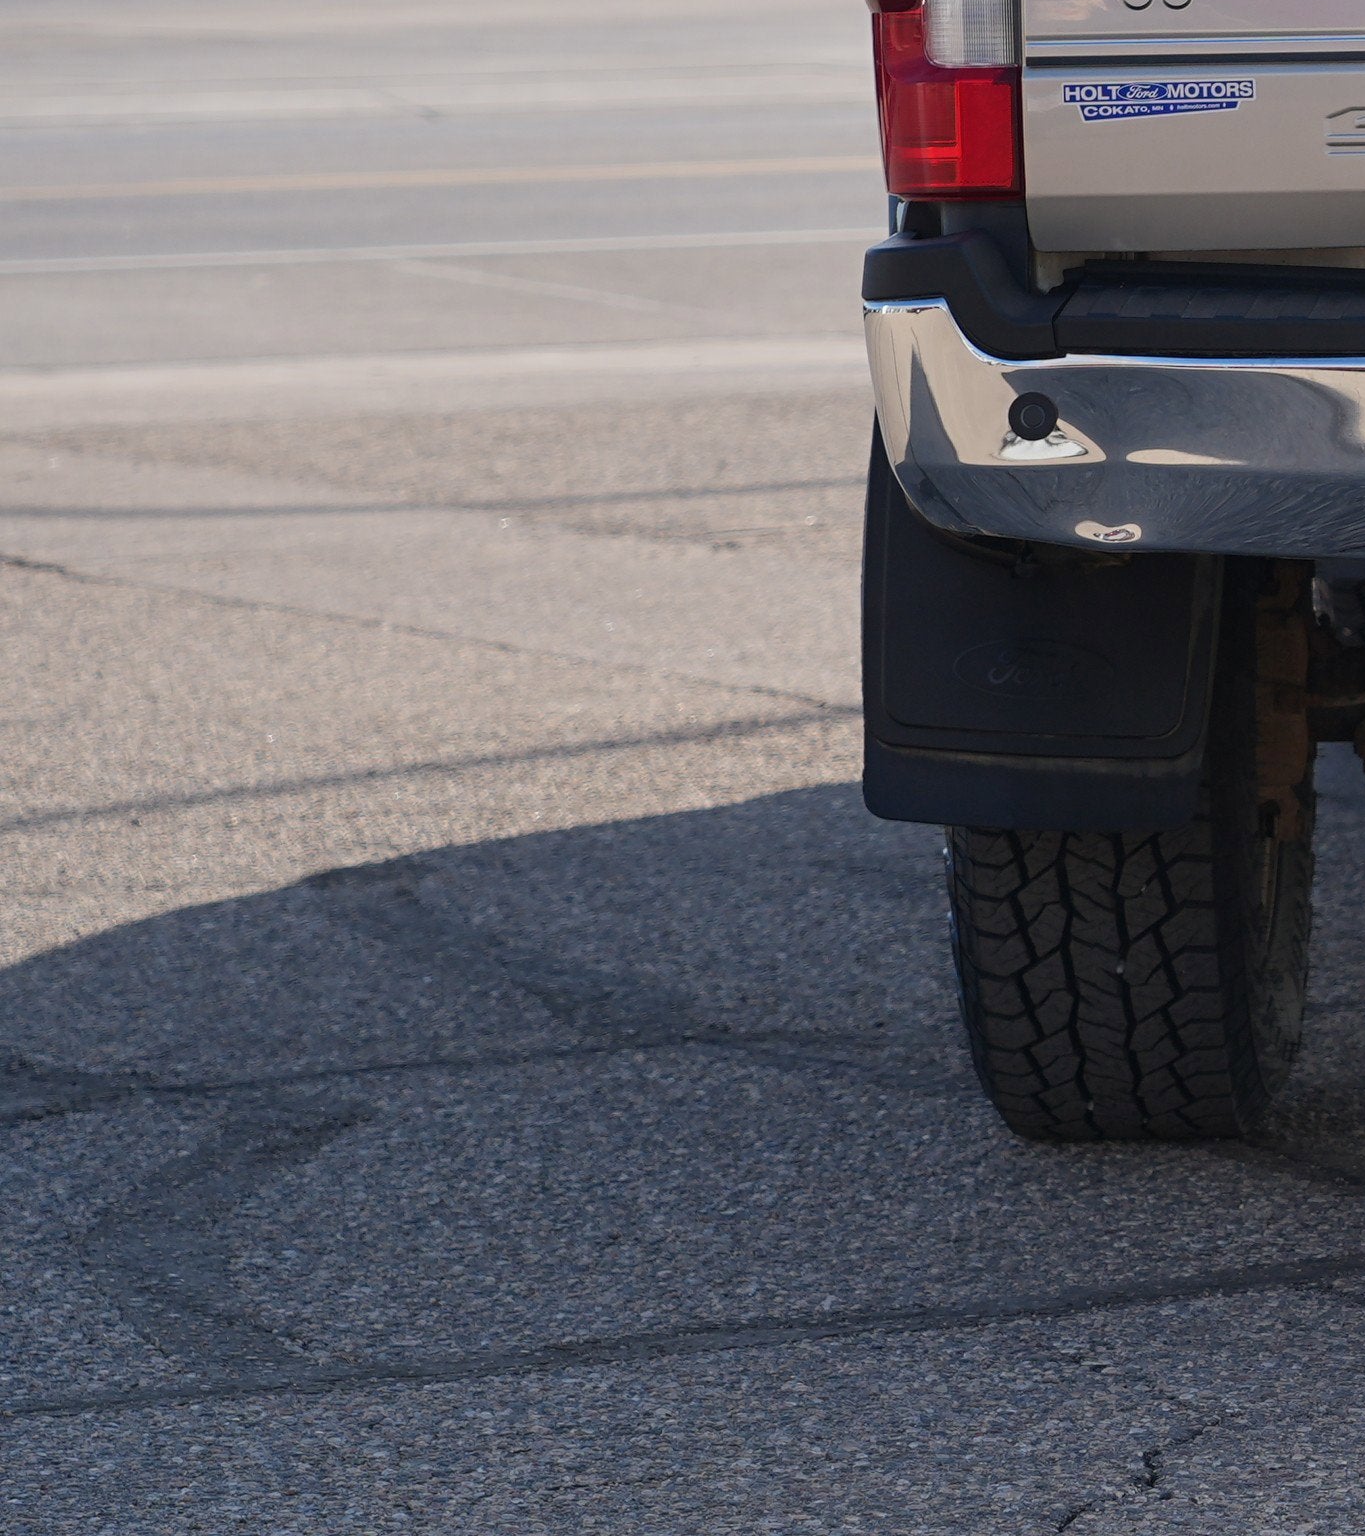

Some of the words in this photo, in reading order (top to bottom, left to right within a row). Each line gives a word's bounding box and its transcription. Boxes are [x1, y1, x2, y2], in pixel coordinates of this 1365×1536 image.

[1065, 84, 1119, 101] HOLT
[1126, 83, 1159, 99] Ford
[1166, 81, 1253, 98] MOTORS
[1083, 105, 1150, 117] COKATO,
